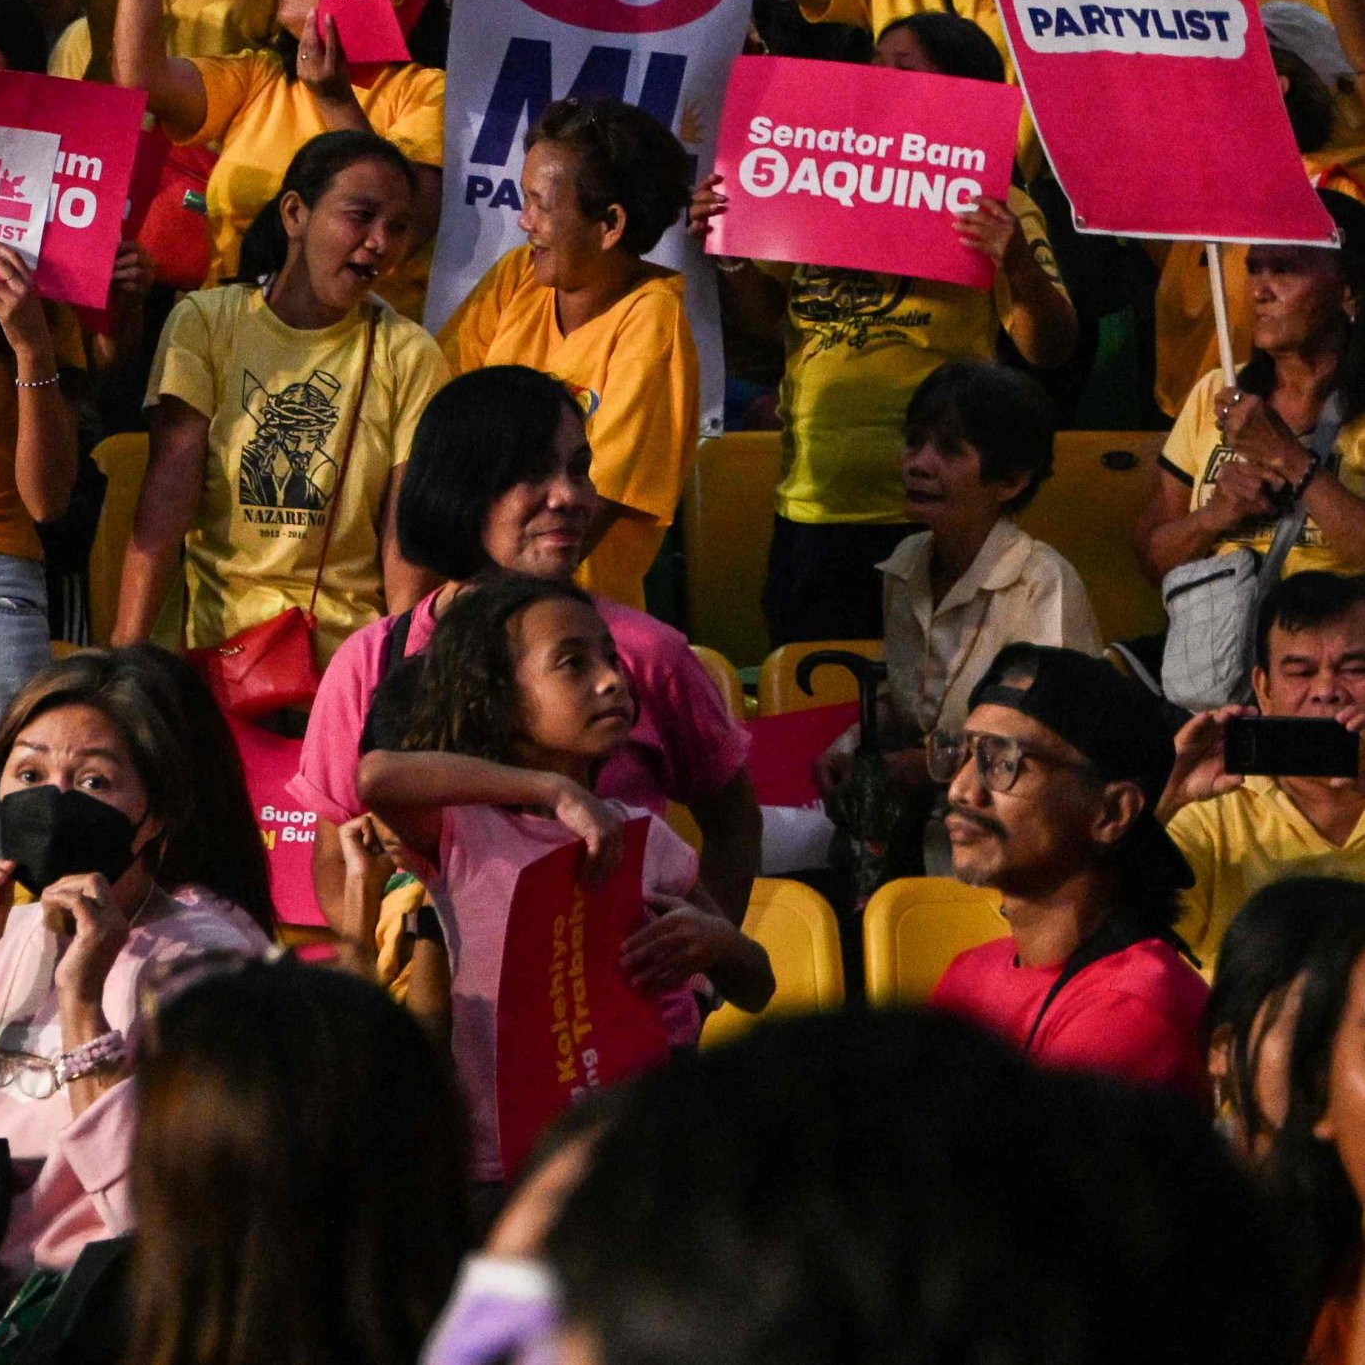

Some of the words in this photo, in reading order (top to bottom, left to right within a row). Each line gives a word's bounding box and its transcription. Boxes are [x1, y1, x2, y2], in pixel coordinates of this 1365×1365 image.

[1028, 5, 1231, 42] PARTYLIST
[748, 116, 890, 156] Senator
[900, 132, 986, 172] Bam
[243, 508, 326, 527] NAZARENO
[550, 912, 577, 1085] Kolehiyo
